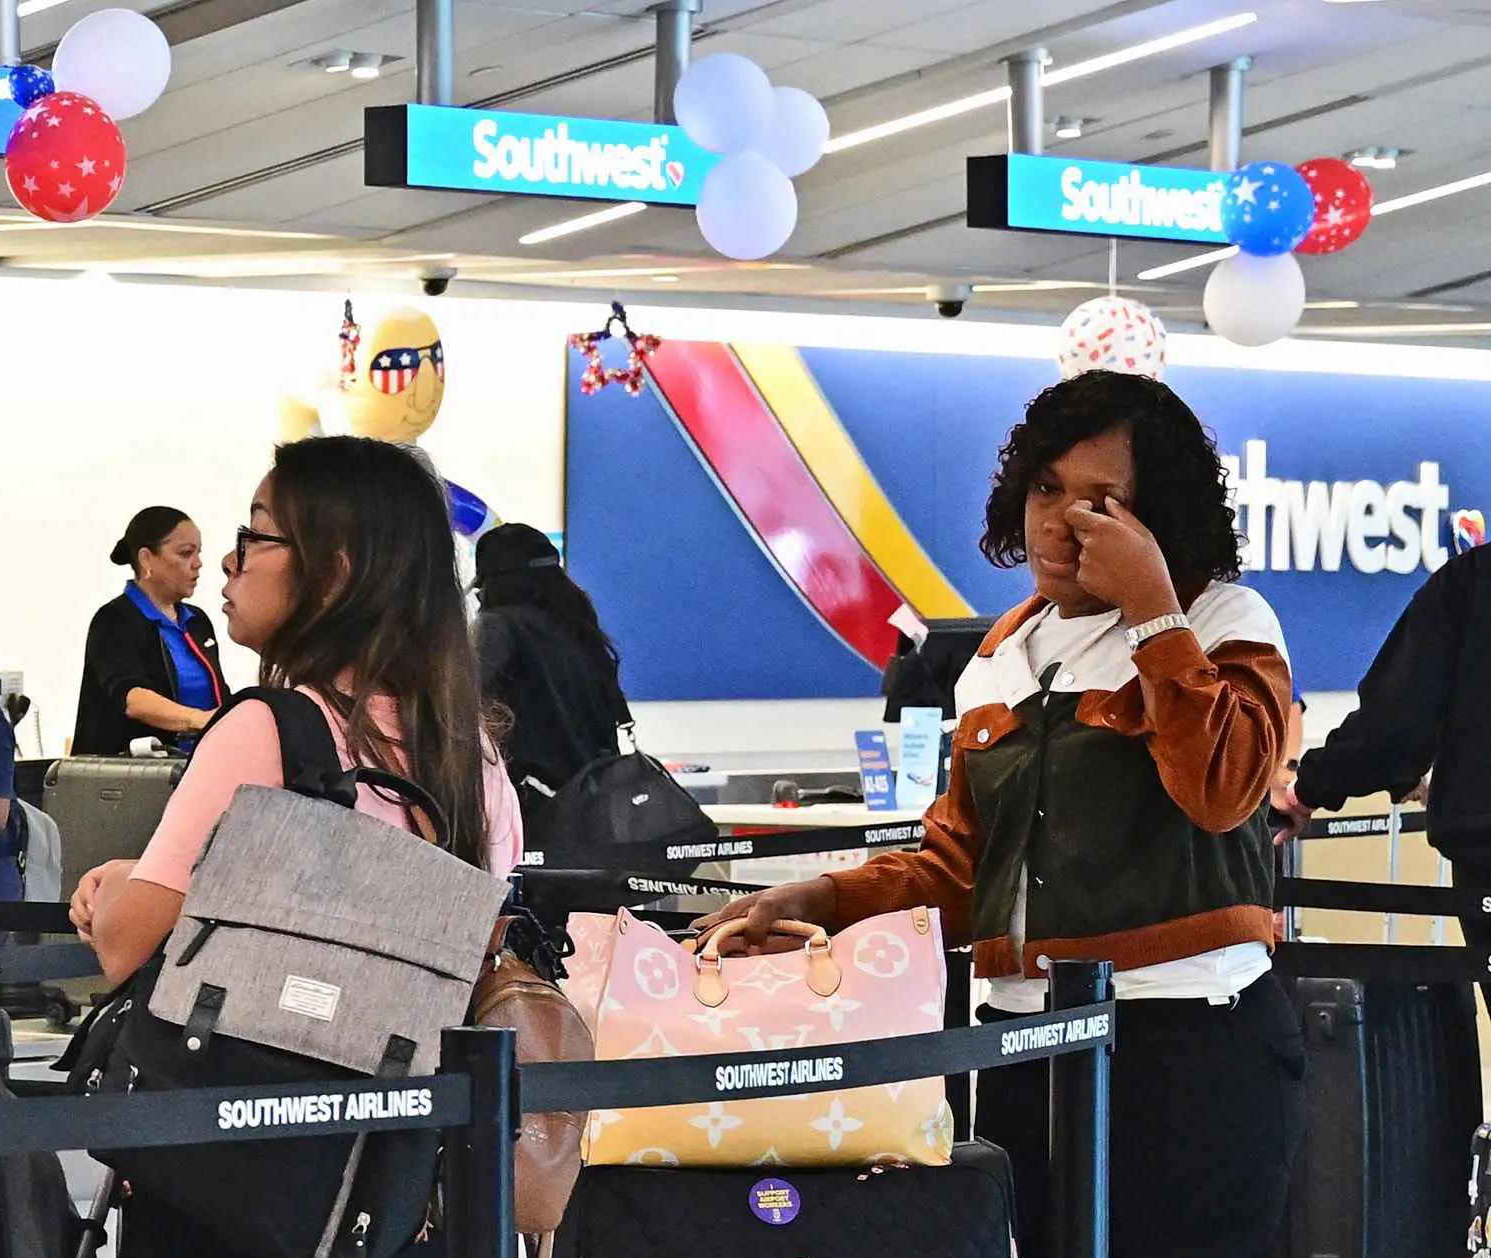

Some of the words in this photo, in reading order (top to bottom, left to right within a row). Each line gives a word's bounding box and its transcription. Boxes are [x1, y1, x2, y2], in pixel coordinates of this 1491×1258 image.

[473, 119, 666, 191] Southwest
[1061, 167, 1224, 232] Southwest
[667, 842, 716, 860] SOUTHWEST
[717, 840, 753, 856] AIRLINES
[864, 827, 911, 844] SOUTHWEST
[1001, 1024, 1064, 1057] SOUTHWEST
[1065, 1013, 1109, 1045] AIRLINES
[715, 1061, 790, 1091] SOUTHWEST
[790, 1056, 844, 1085] AIRLINES
[218, 1095, 344, 1130] SOUTHWEST
[345, 1088, 433, 1120] AIRLINES
